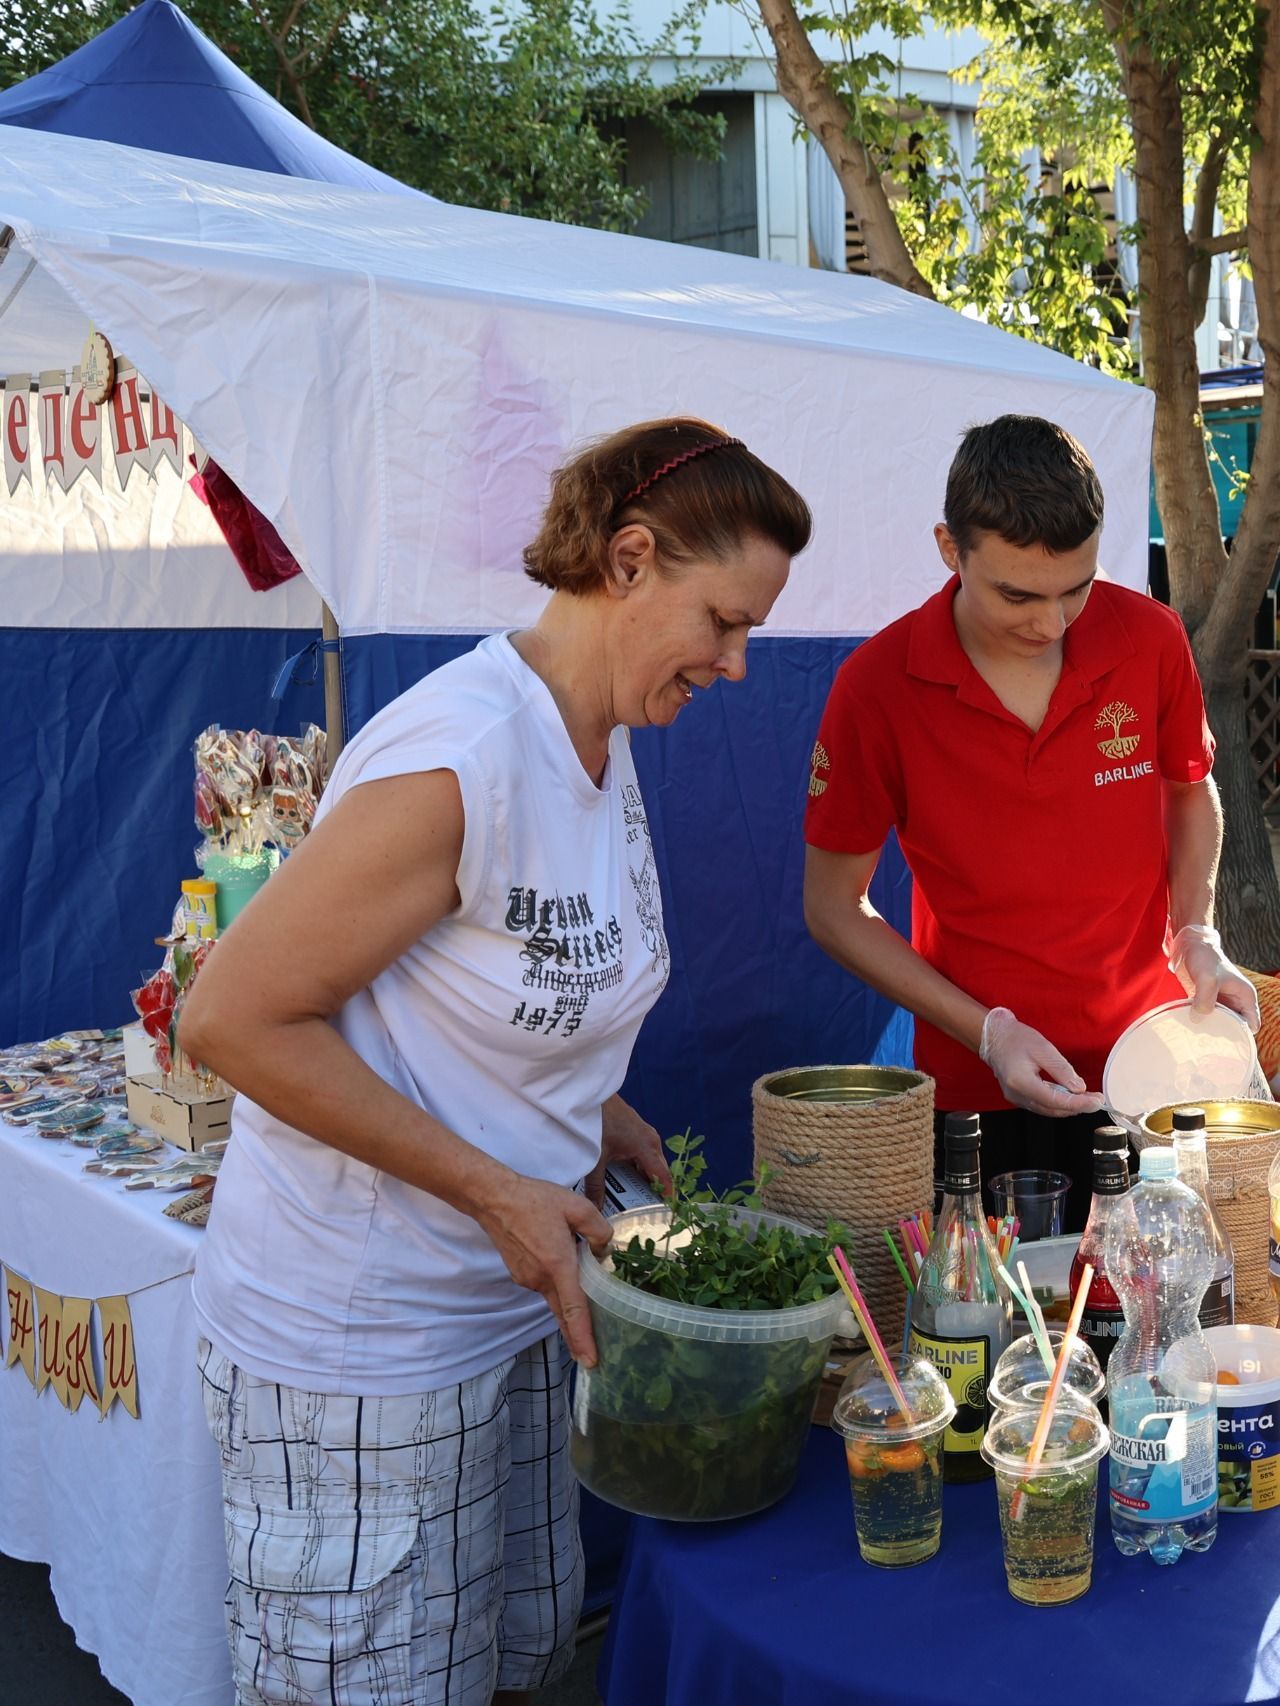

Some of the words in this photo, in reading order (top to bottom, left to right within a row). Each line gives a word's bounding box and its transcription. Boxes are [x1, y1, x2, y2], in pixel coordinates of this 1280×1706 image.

[1094, 761, 1154, 787] BARLINE
[505, 886, 594, 932] Urban
[522, 960, 624, 994] Underground
[555, 994, 590, 1011] since
[509, 1001, 584, 1038] 1975
[1218, 1414, 1274, 1433] ента
[1218, 1442, 1245, 1451] овый
[1260, 1471, 1275, 1480] 55%
